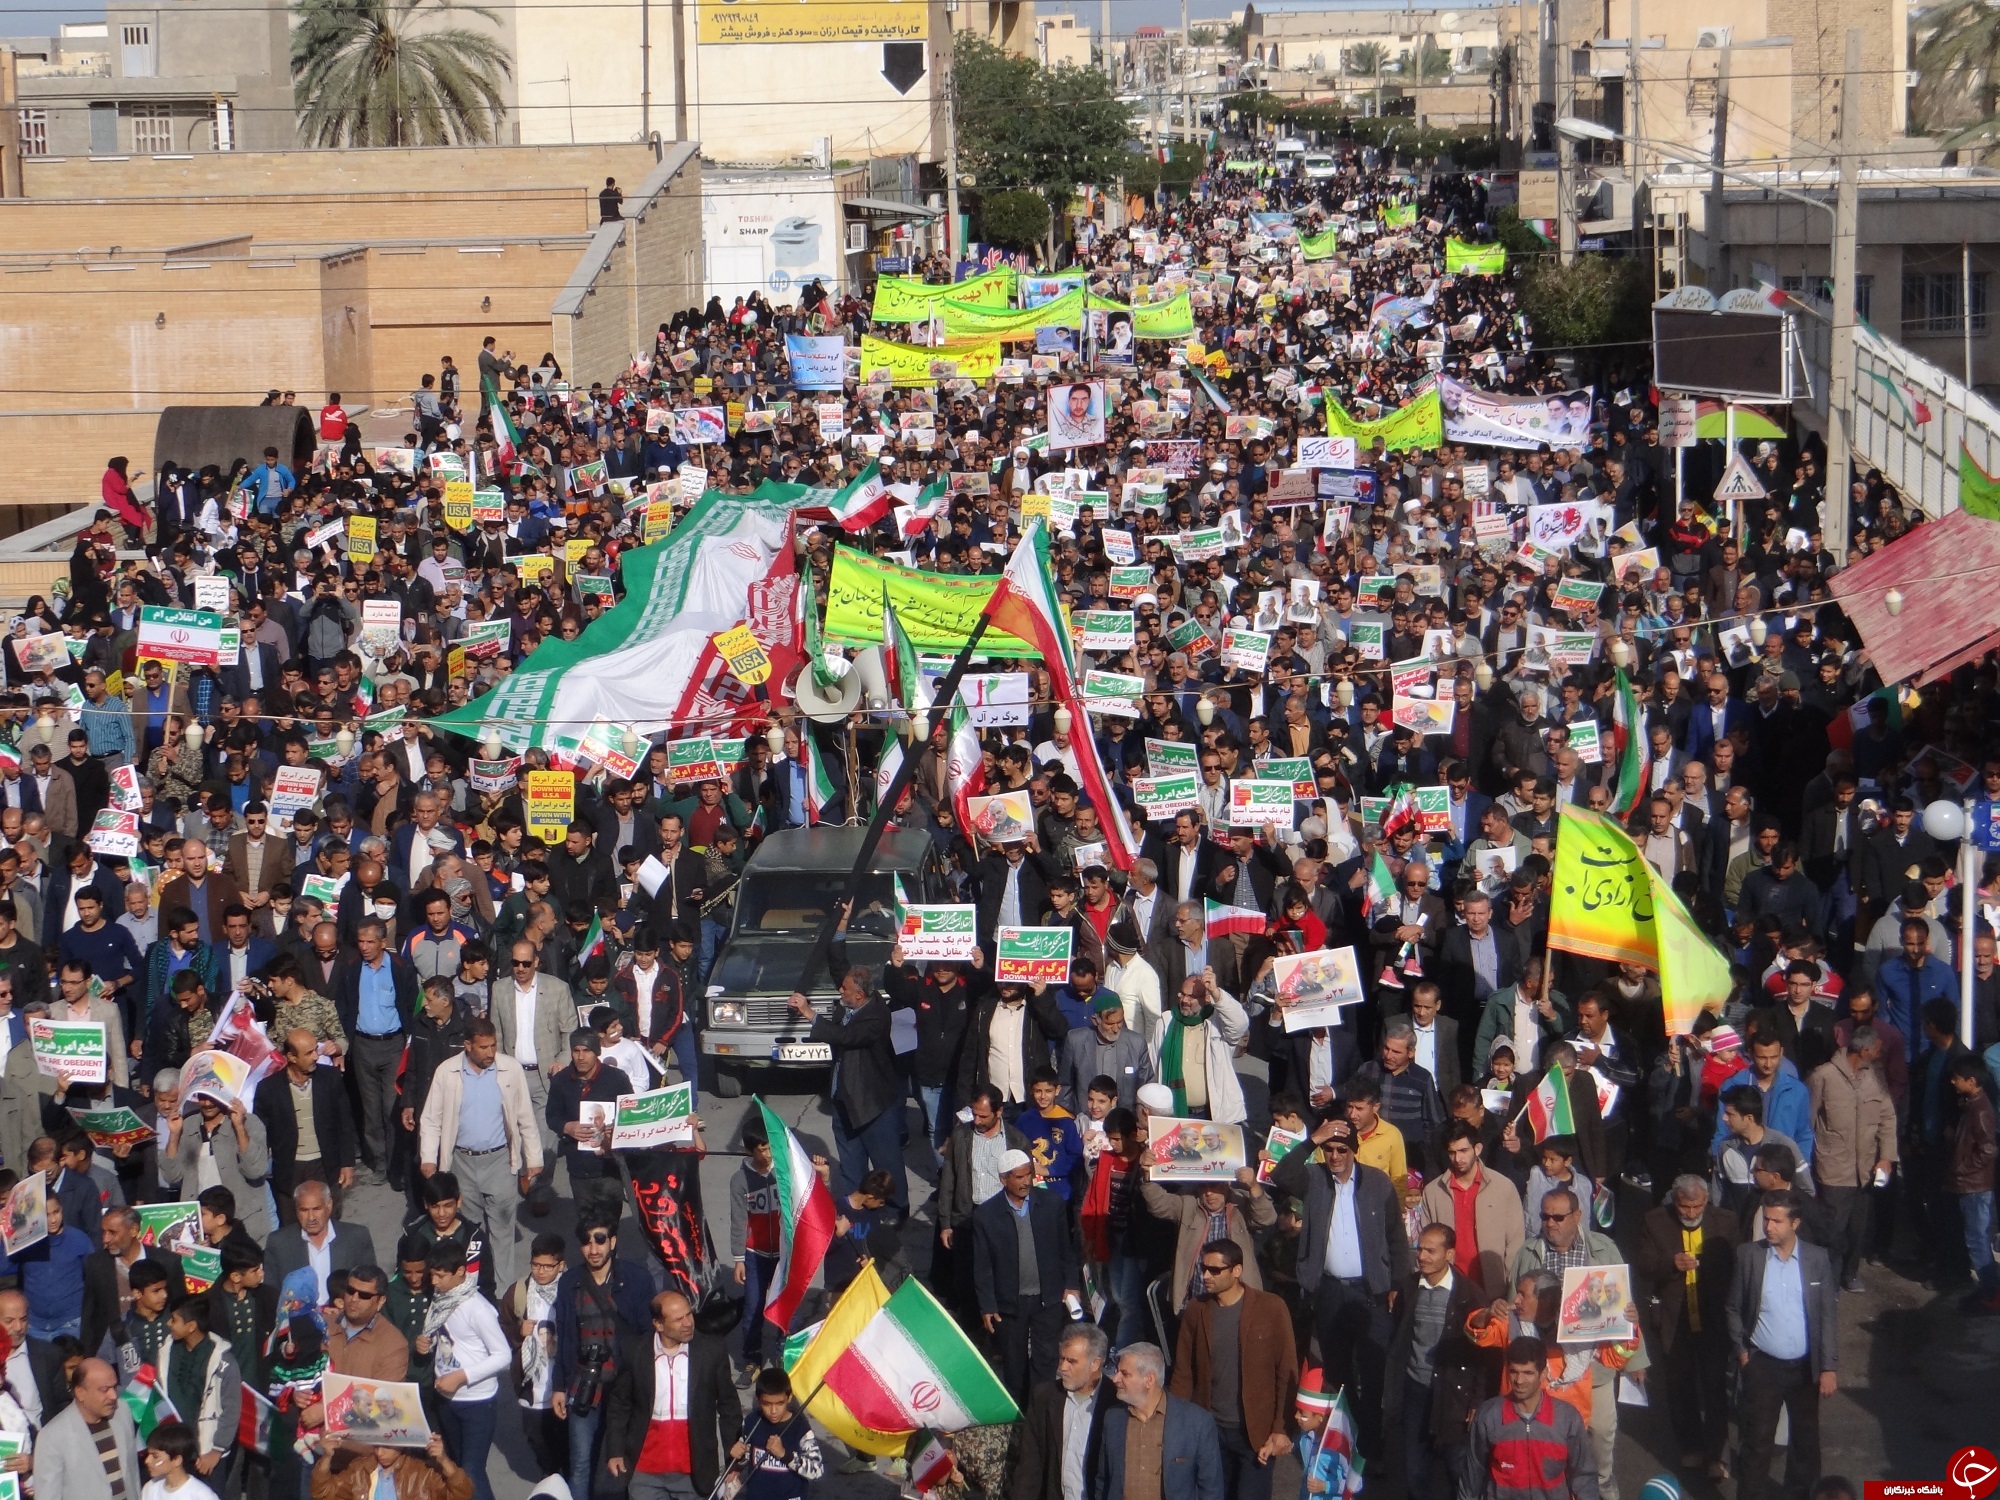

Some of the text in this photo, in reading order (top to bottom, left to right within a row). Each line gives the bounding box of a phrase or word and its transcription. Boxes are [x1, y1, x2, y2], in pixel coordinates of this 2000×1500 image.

[448, 507, 469, 516] USA
[351, 541, 370, 553] USA
[152, 610, 213, 626] من انقلابی ام
[737, 655, 764, 673] USA
[977, 711, 1019, 724] مرگ بر آل
[279, 780, 298, 788] DOWN
[472, 775, 497, 787] آمریکا
[531, 775, 550, 784] آمریکا
[1164, 788, 1176, 800] امر
[1176, 786, 1196, 799] مطیع
[1294, 784, 1314, 794] مرگ
[1150, 800, 1198, 811] ARE OBEDIENT
[1232, 806, 1246, 814] است
[1248, 805, 1267, 813] ملت
[1279, 806, 1290, 814] قیام
[531, 811, 552, 819] DOWN
[540, 817, 562, 825] ISRAEL
[105, 836, 135, 849] مرگ بر
[900, 933, 972, 945] قیام یک ملت است
[942, 947, 962, 957] مقابل
[1000, 959, 1067, 976] مرگ بر آمریکا
[1003, 973, 1027, 982] DOWN
[1331, 987, 1344, 998] ۲۲
[63, 1040, 78, 1055] امر
[77, 1040, 104, 1055] مطیع
[63, 1058, 104, 1069] OBEDIENT
[1161, 1160, 1227, 1175] ۲۲ بهمن
[1606, 1316, 1617, 1327] ۲۲
